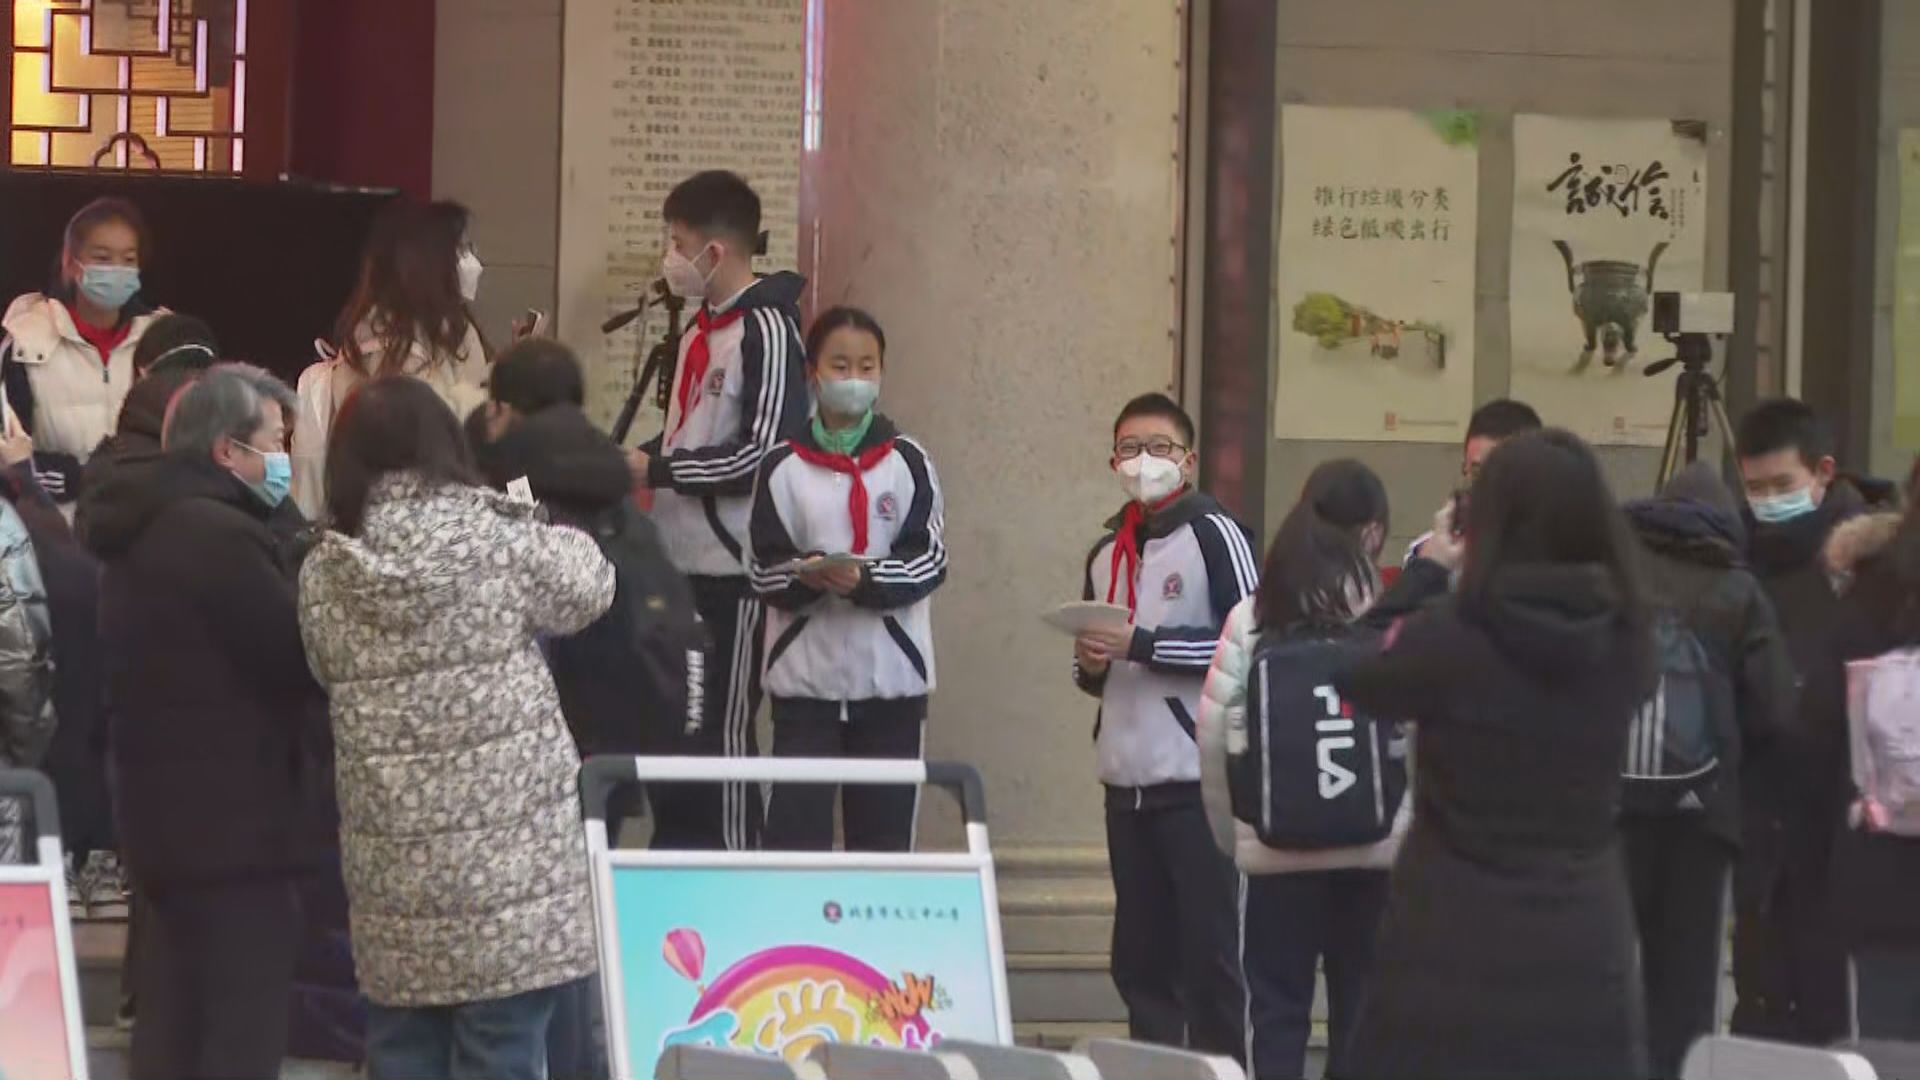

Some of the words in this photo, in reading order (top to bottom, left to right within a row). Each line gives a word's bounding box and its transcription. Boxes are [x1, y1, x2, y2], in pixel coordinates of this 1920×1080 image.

[1314, 185, 1450, 211] 推行垃圾分类
[1312, 216, 1452, 241] 绿色低碳出行
[1313, 684, 1357, 799] FILA
